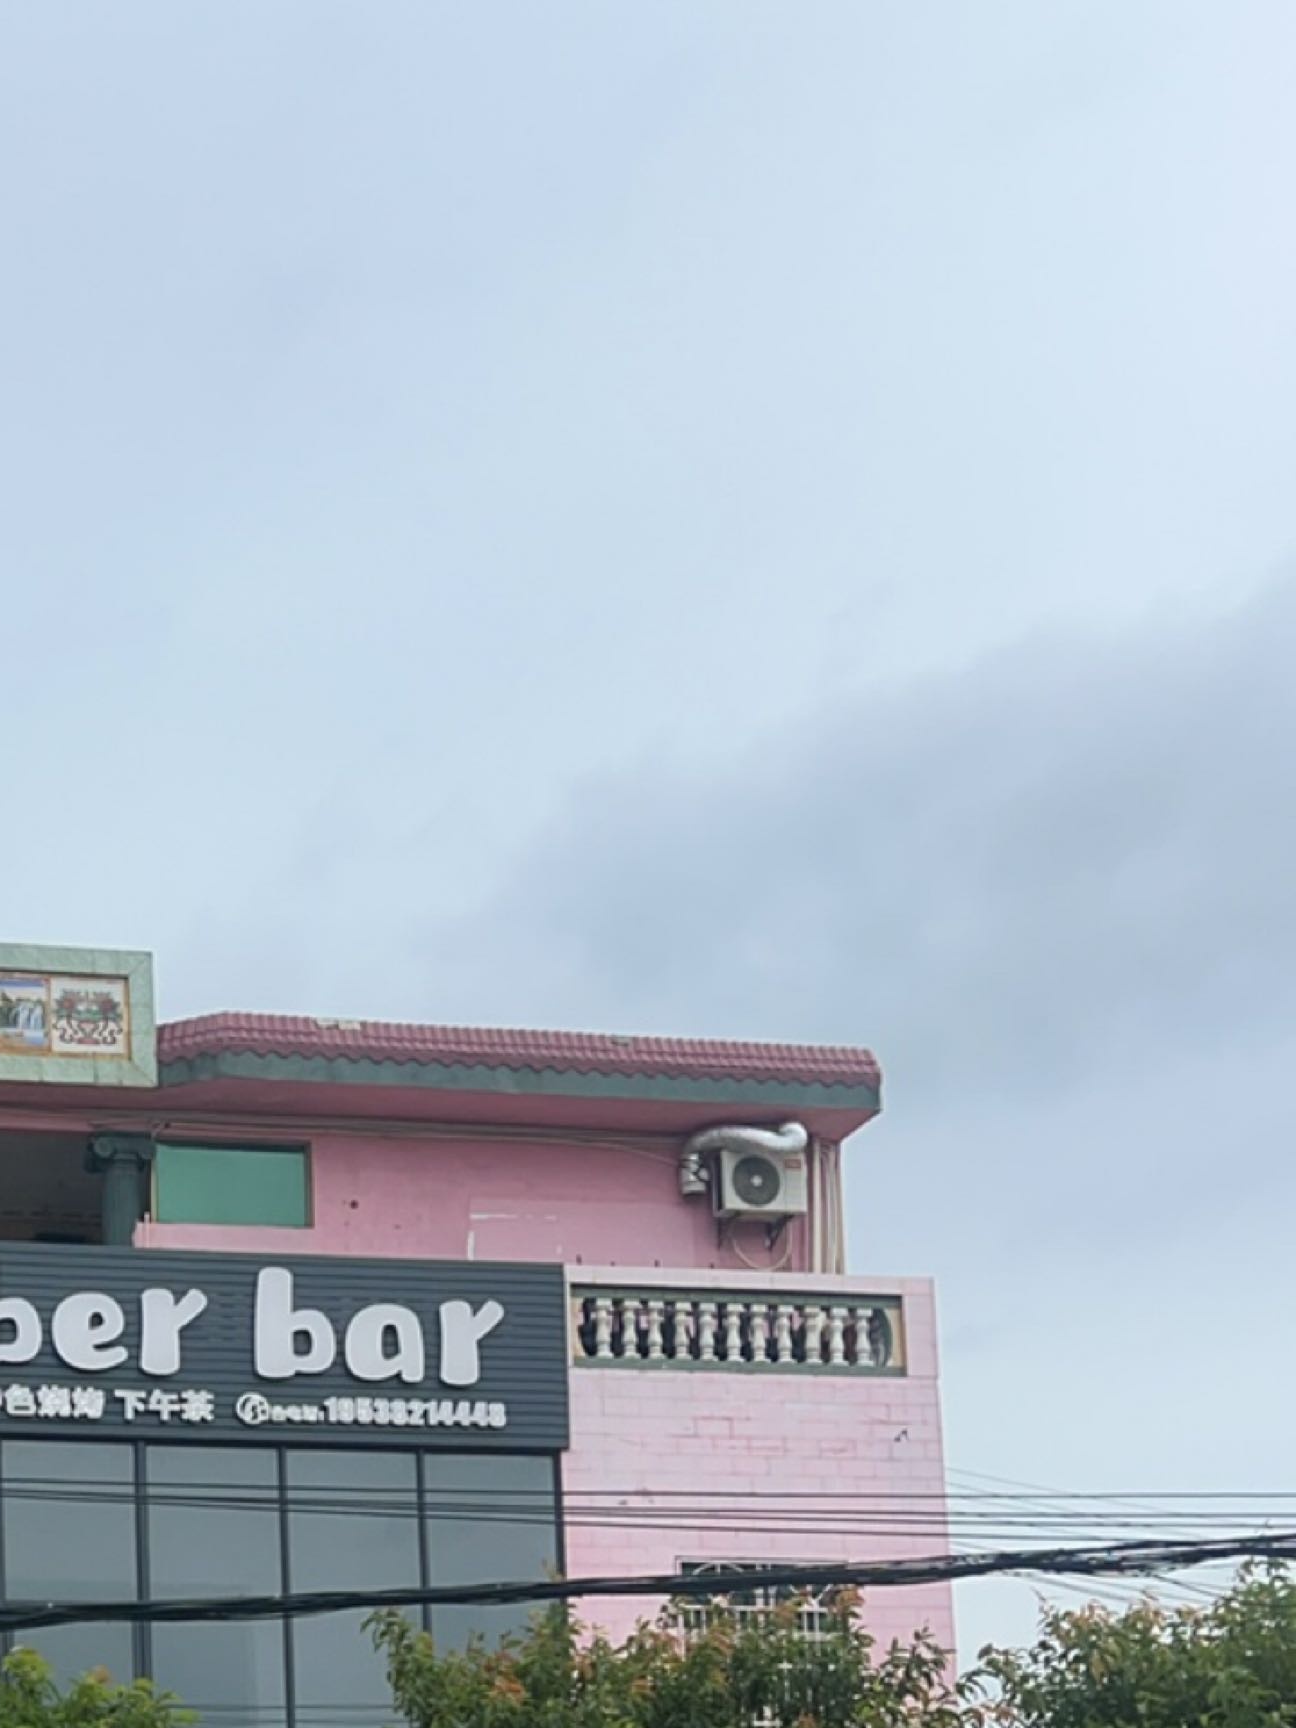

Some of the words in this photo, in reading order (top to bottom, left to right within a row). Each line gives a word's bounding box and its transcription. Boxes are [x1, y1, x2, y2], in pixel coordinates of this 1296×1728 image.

[254, 1265, 505, 1385] bar
[114, 1389, 215, 1423] 下午茶
